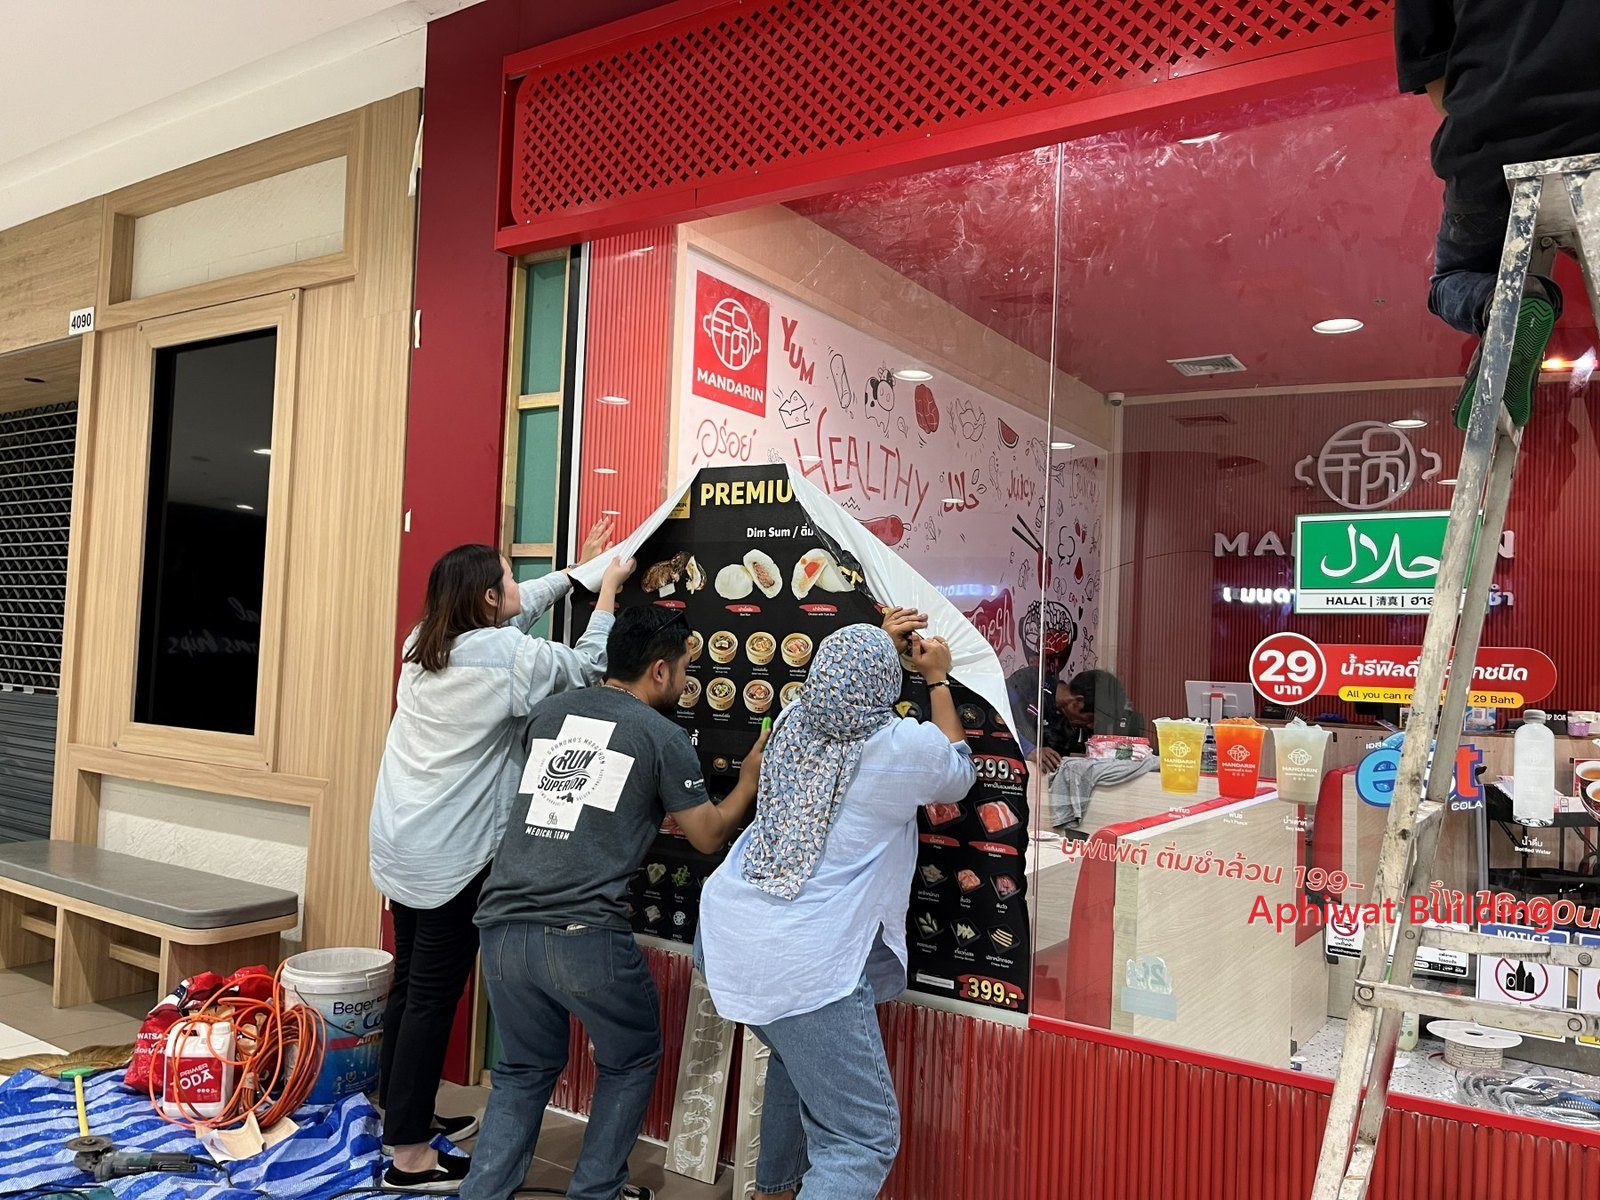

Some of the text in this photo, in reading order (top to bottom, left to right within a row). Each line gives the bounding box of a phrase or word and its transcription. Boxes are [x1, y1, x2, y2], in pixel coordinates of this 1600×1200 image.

[71, 313, 92, 330] 4090
[781, 315, 815, 385] YUM
[697, 367, 764, 404] MANDARIN
[793, 407, 929, 523] HEALTHY
[700, 479, 800, 506] PREMIU
[746, 527, 767, 538] Dim
[768, 526, 791, 538] Sum
[1325, 596, 1367, 606] HALAL
[1258, 648, 1317, 683] 29
[1273, 683, 1303, 696] บาท
[1346, 689, 1359, 699] All
[1362, 691, 1380, 703] you
[1382, 692, 1401, 700] can
[1472, 694, 1488, 704] 29
[1490, 694, 1515, 705] Baht
[556, 749, 598, 770] RUN
[1163, 757, 1197, 765] MANDARIN
[537, 775, 588, 792] SUPERIOR
[1356, 743, 1484, 808] et
[1451, 801, 1483, 812] COLA
[525, 826, 571, 840] MEDICAL TEAM
[967, 977, 1018, 1005] 399.-
[333, 997, 375, 1016] Beger
[137, 1032, 168, 1040] WATSA
[180, 1063, 208, 1078] PRIMER
[170, 1069, 215, 1090] ODA
